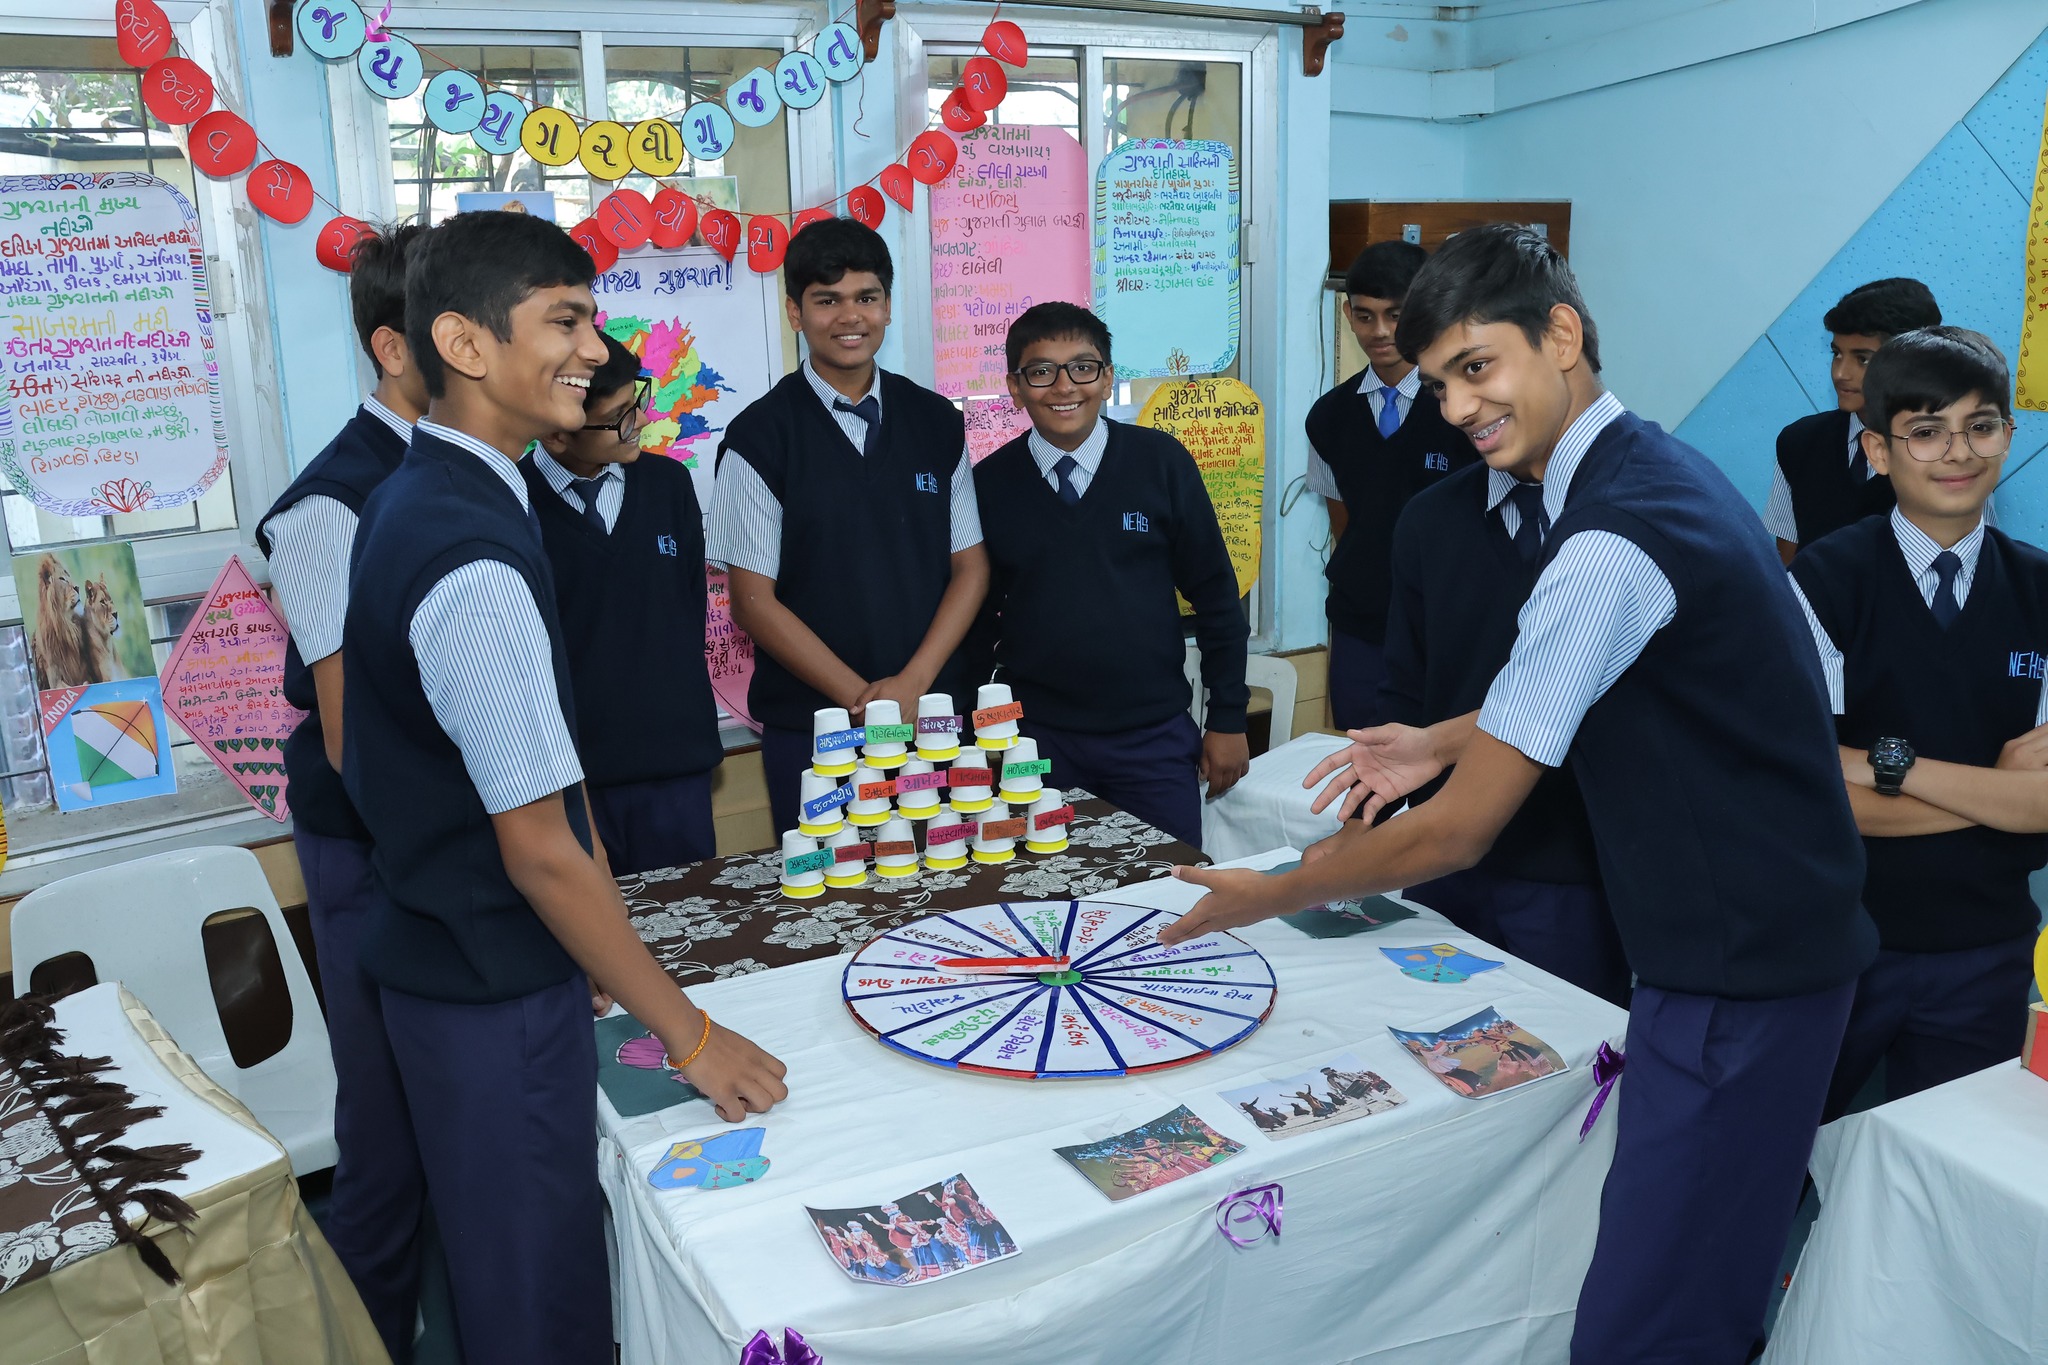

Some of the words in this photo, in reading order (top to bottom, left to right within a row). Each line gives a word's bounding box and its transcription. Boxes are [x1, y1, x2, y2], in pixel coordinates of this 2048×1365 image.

[94, 196, 141, 217] મુખ્ય
[1424, 452, 1449, 472] NEHS
[915, 471, 939, 494] NEHS
[1122, 511, 1149, 533] NEHS
[45, 689, 79, 725] INDIA
